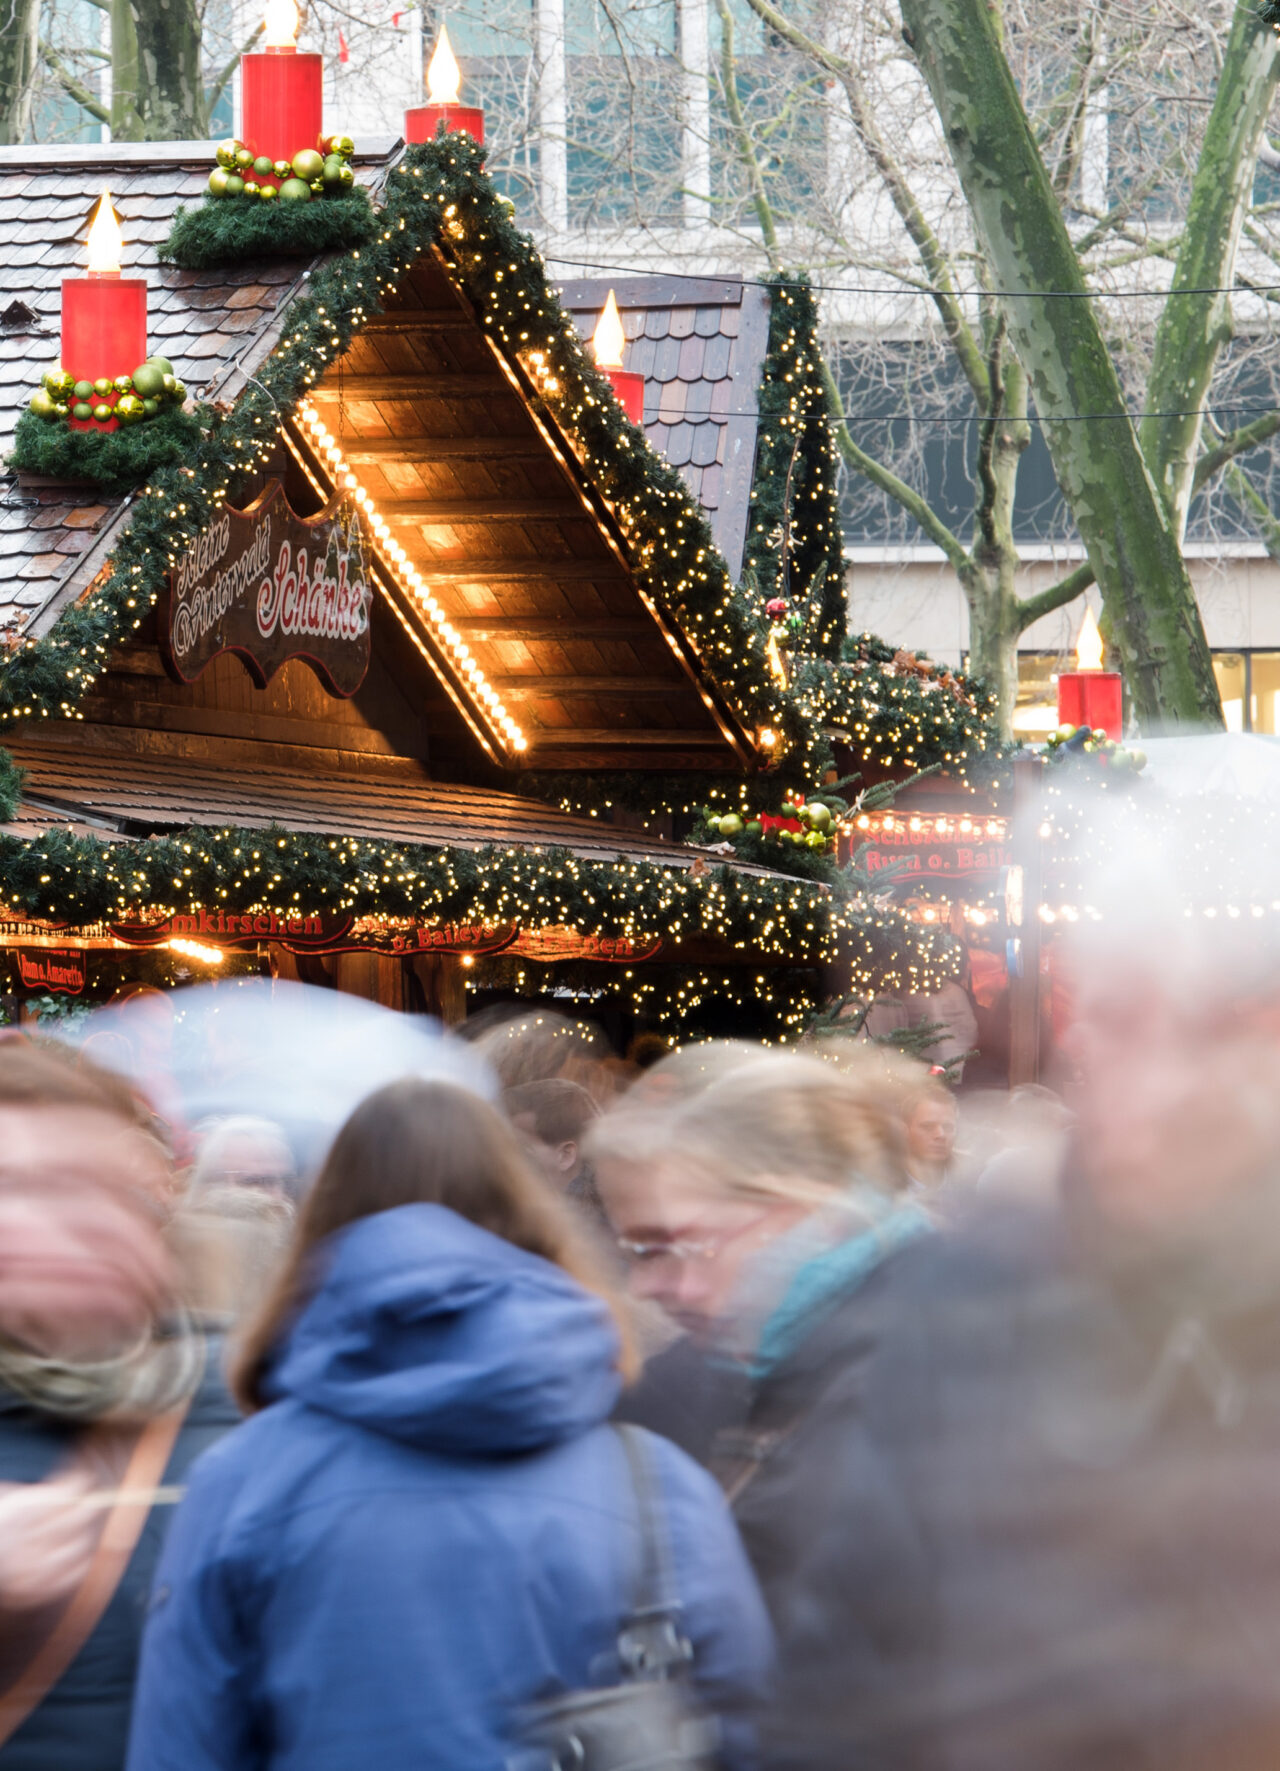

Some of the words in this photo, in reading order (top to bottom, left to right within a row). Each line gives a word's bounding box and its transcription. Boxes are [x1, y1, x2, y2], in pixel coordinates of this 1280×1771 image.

[173, 513, 271, 657] Winterwald
[256, 539, 368, 642] Schänke
[417, 923, 495, 948] Baileys
